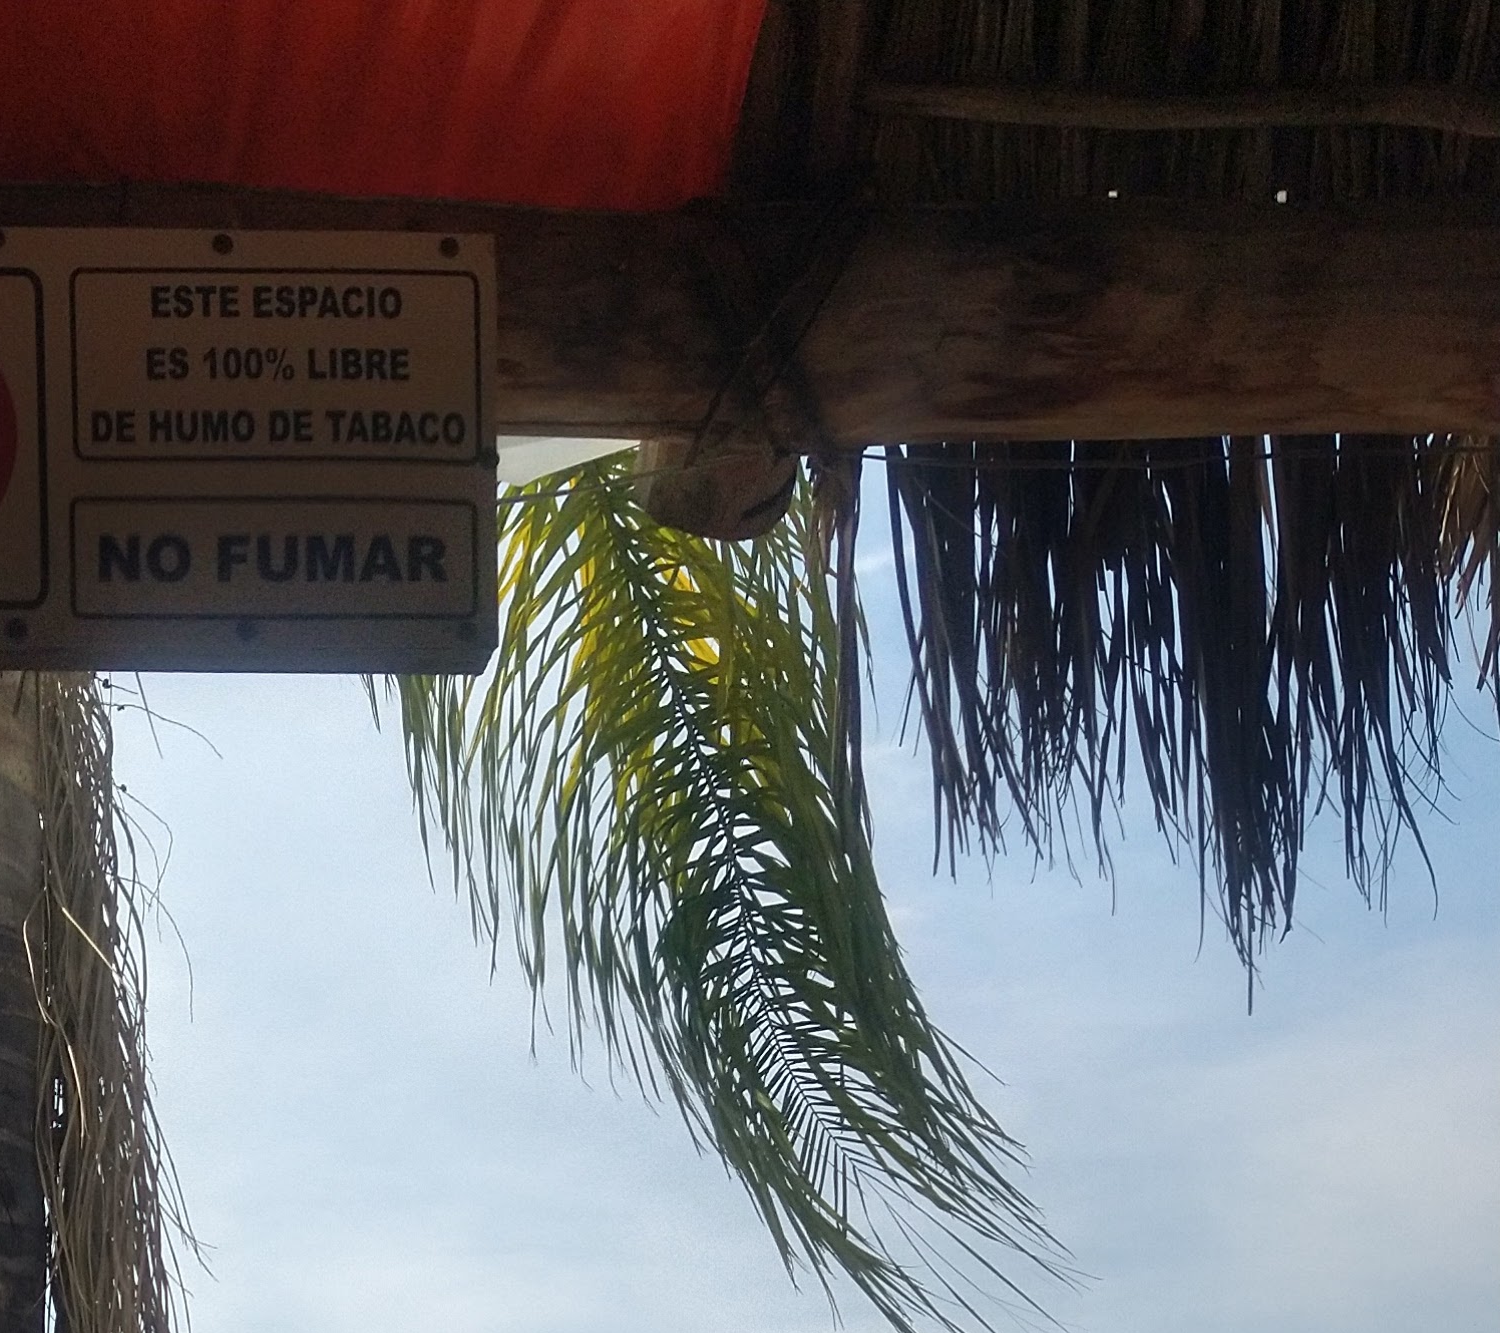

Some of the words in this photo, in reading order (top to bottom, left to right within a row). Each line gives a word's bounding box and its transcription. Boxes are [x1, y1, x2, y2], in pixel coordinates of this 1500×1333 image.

[150, 286, 240, 319] ESTE
[252, 286, 403, 320] ESPACIO
[145, 347, 190, 381] ES
[202, 347, 296, 382] 100%
[307, 348, 411, 382] LIBRE
[91, 409, 135, 443] DE
[148, 409, 255, 444] HUMO
[268, 410, 314, 444] DE
[324, 410, 467, 448] TABACO
[98, 533, 192, 584] NO
[217, 534, 449, 584] FUMAR
